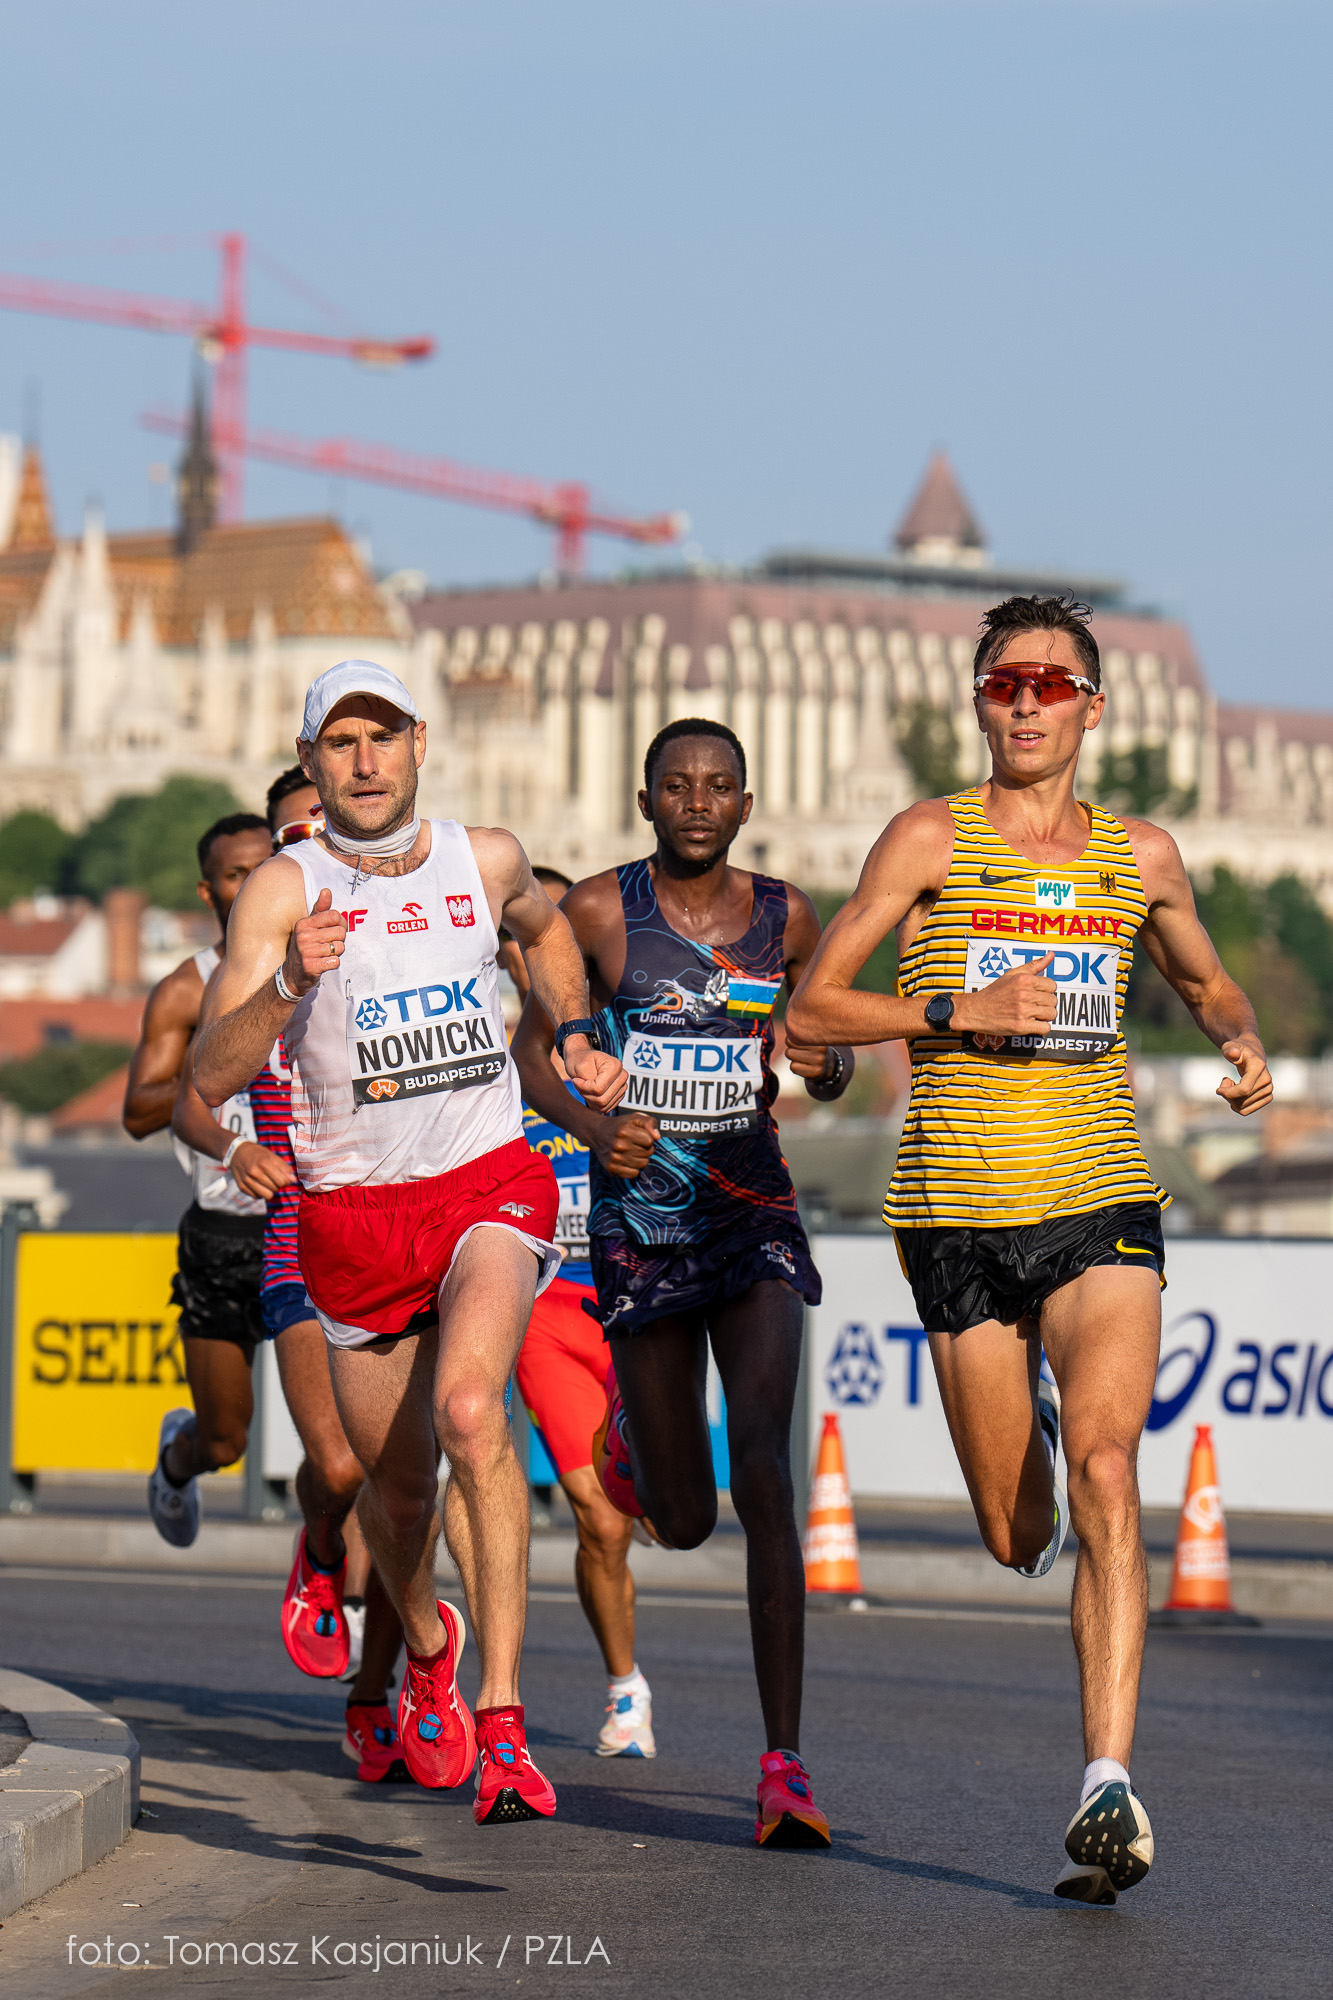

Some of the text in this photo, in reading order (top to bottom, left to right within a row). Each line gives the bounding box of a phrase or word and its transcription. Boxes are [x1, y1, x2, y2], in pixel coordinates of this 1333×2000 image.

[389, 919, 427, 933] ORLEN
[971, 908, 1124, 939] GERMANY
[383, 977, 483, 1023] TDK
[1052, 992, 1112, 1029] MANN
[639, 1012, 686, 1026] UniRun
[356, 1017, 495, 1074] NOWICKI
[662, 1043, 752, 1073] TDK
[1011, 1035, 1093, 1052] BUDAPEST
[404, 1060, 503, 1090] BUDAPEST 23
[659, 1117, 750, 1133] BUDAPEST 23
